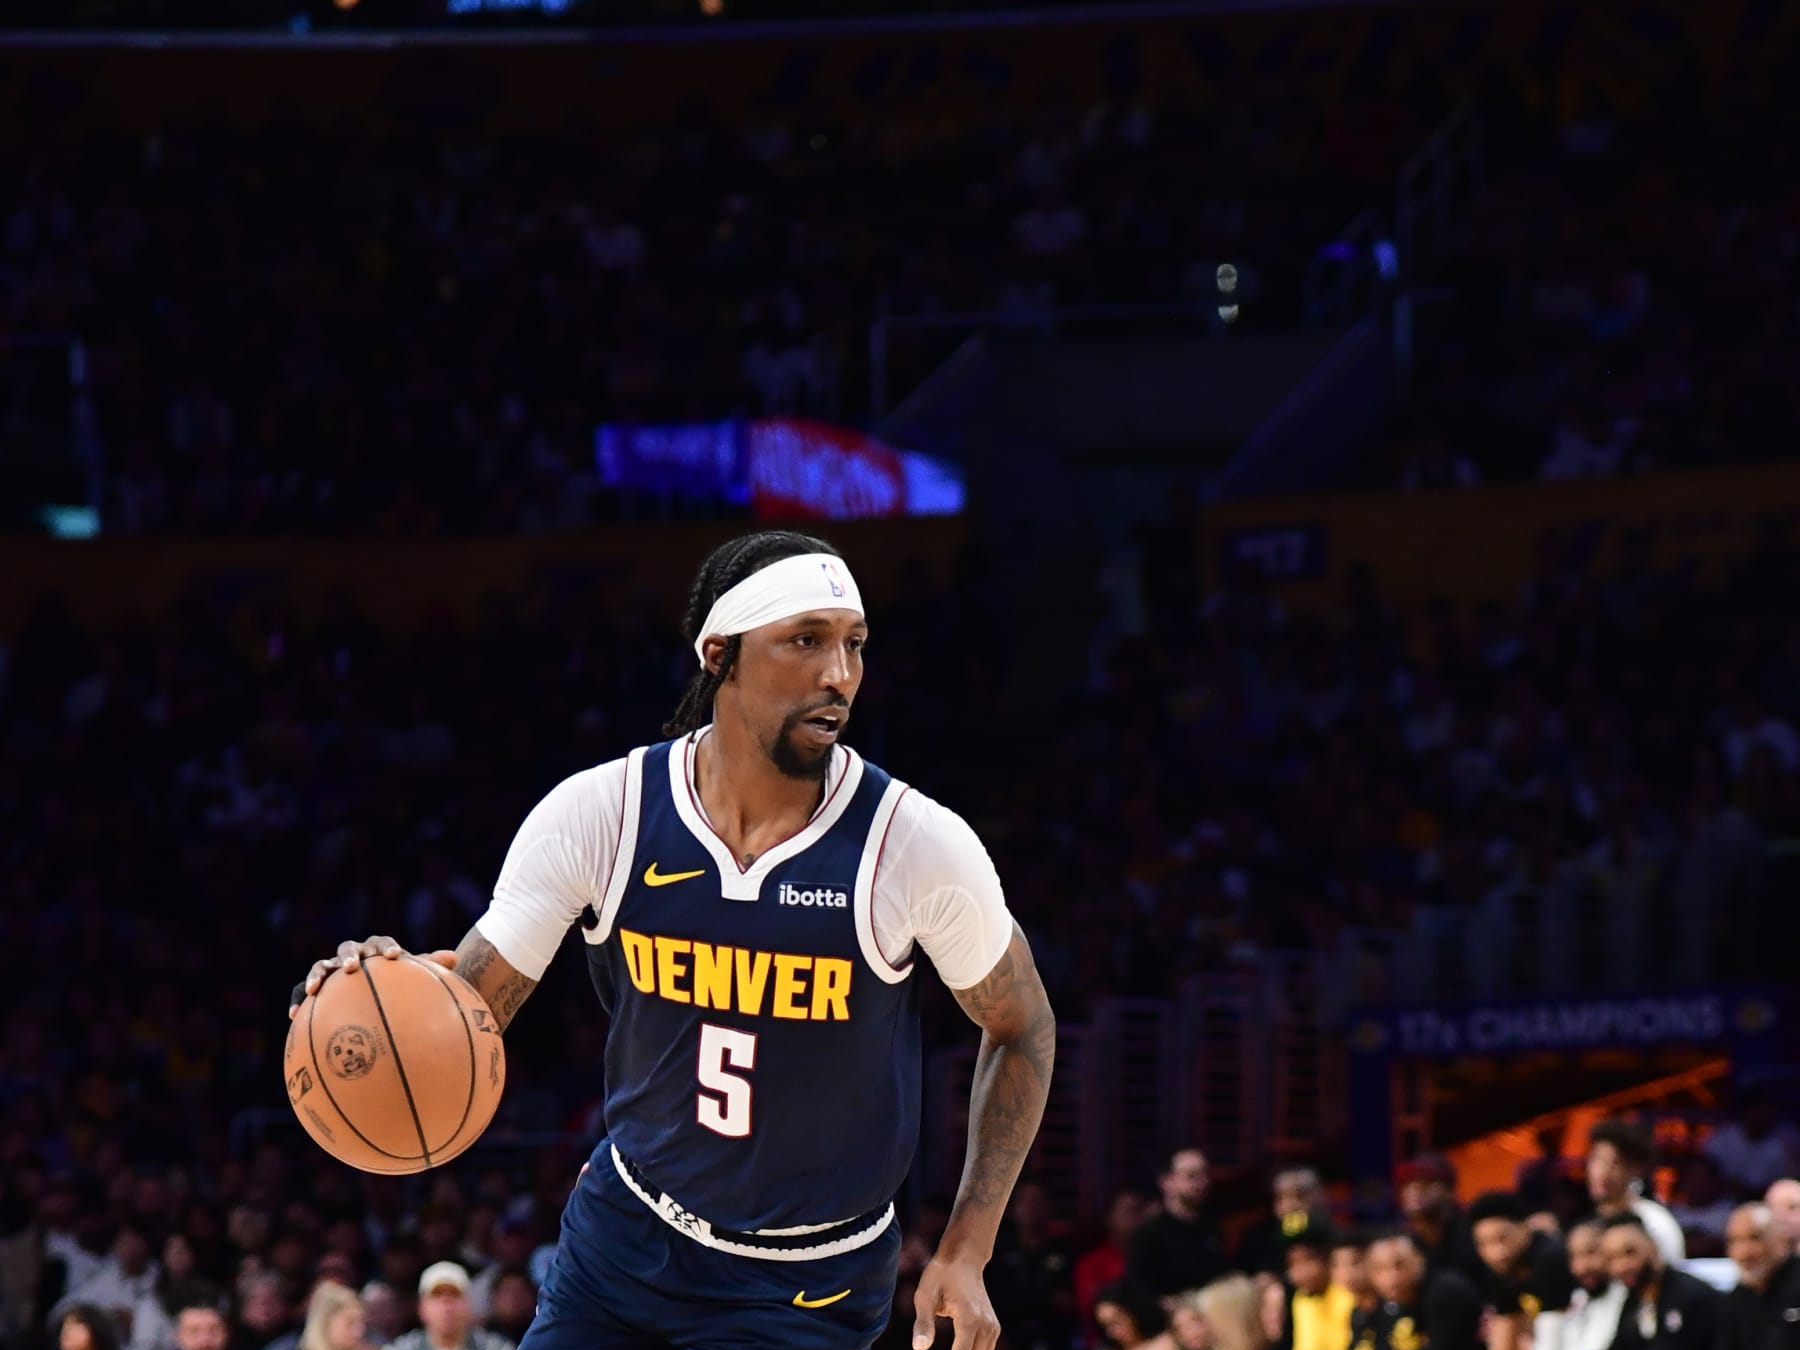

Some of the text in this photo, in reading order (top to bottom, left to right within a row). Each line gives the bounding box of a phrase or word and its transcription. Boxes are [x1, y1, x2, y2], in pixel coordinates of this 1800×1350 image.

[779, 884, 847, 908] ibotta
[619, 927, 853, 1021] DENVER
[1464, 997, 1720, 1046] CHAMPIONS
[697, 1022, 758, 1138] 5
